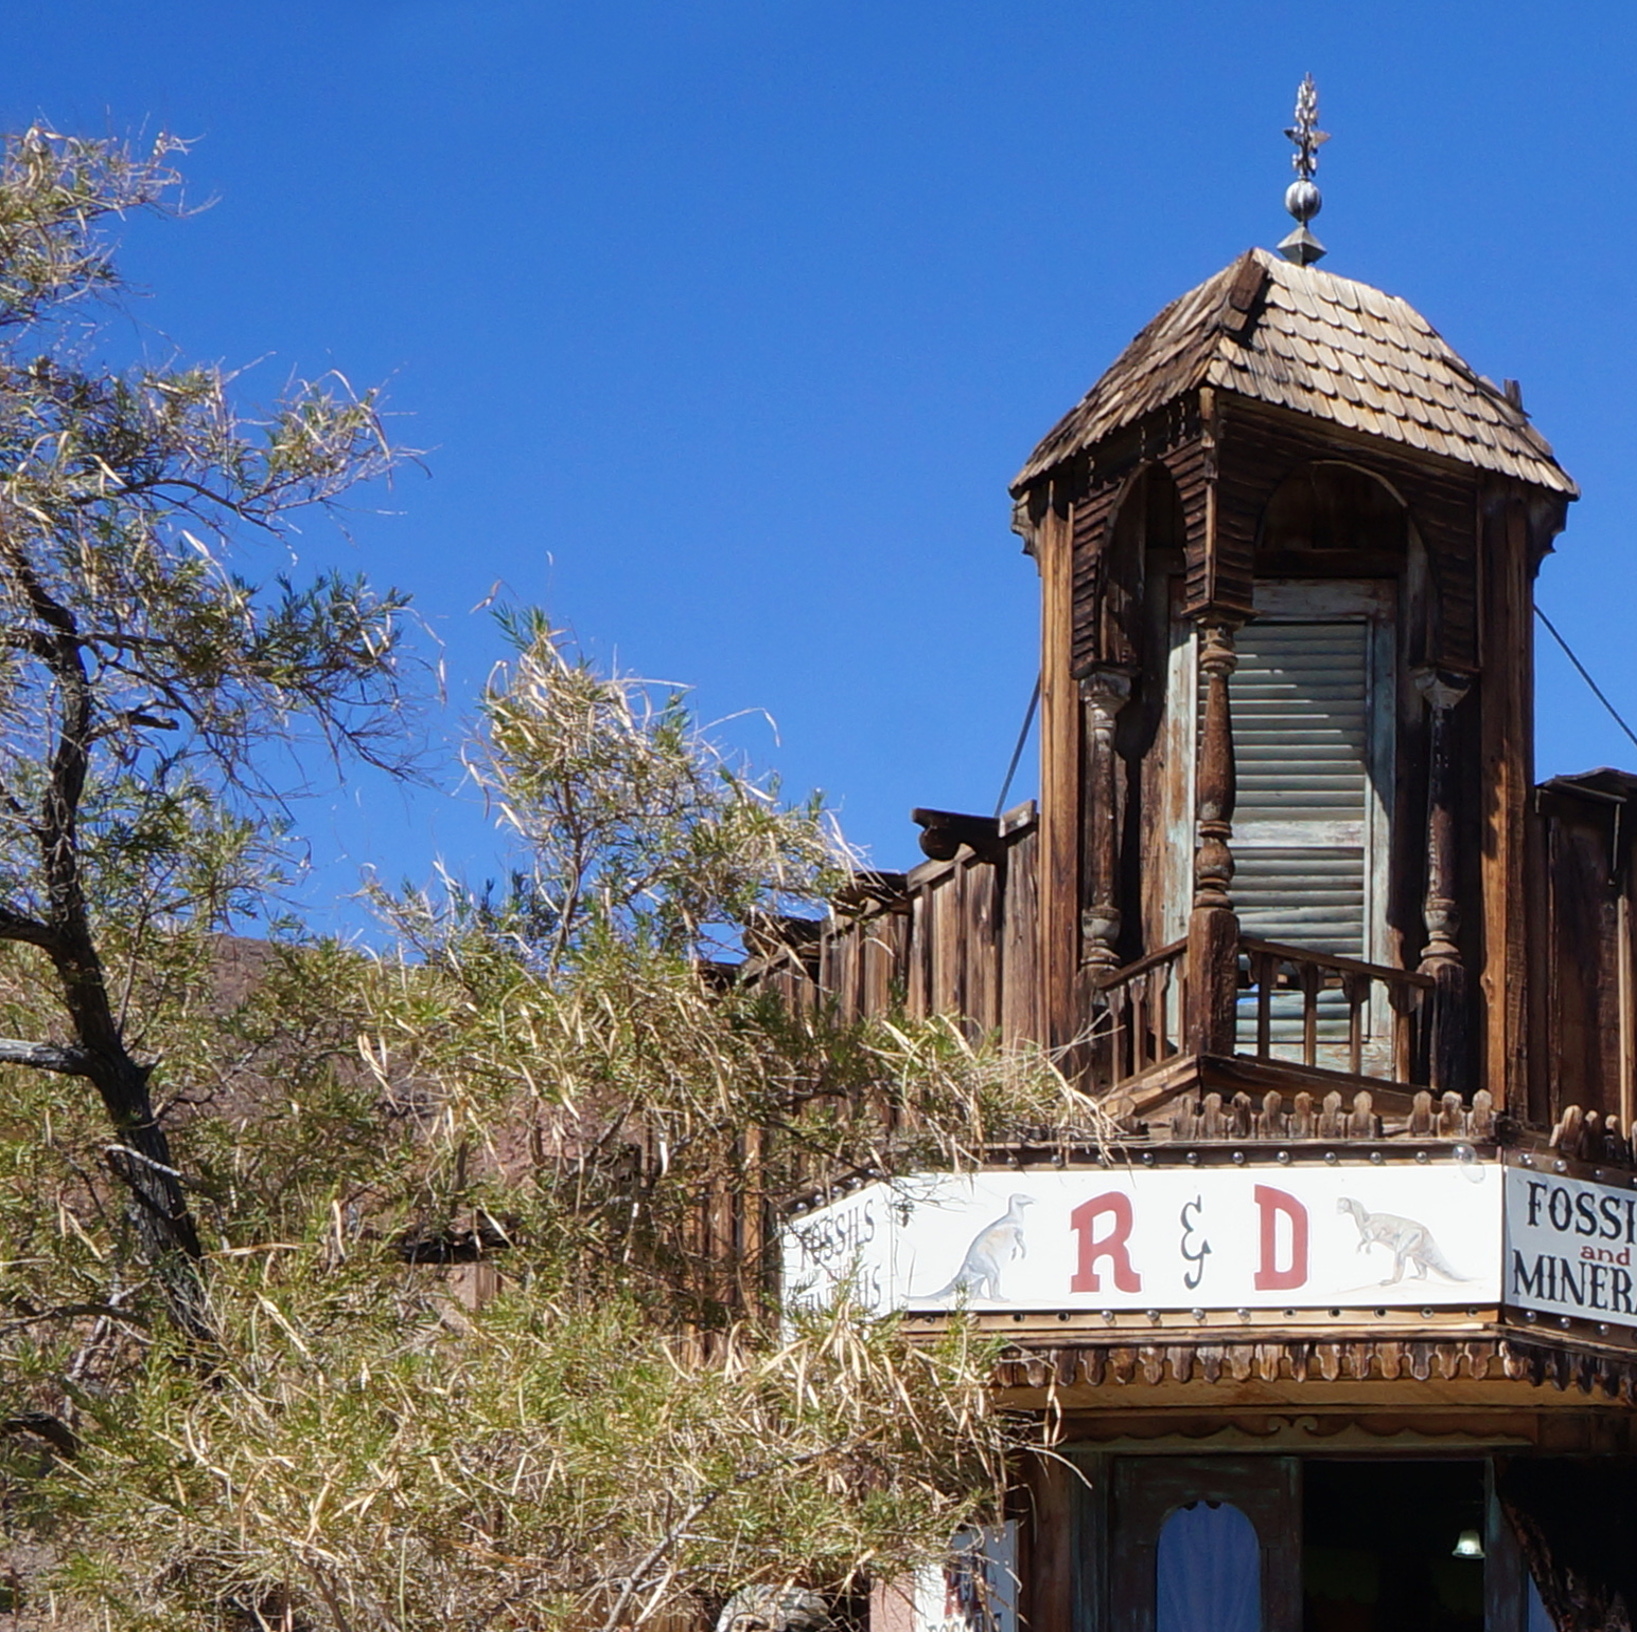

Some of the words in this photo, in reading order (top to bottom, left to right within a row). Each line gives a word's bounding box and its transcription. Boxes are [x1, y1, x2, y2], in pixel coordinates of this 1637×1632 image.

[1070, 1190, 1142, 1293] R
[1180, 1194, 1212, 1290] &
[1253, 1184, 1309, 1291] D
[1580, 1245, 1632, 1267] and
